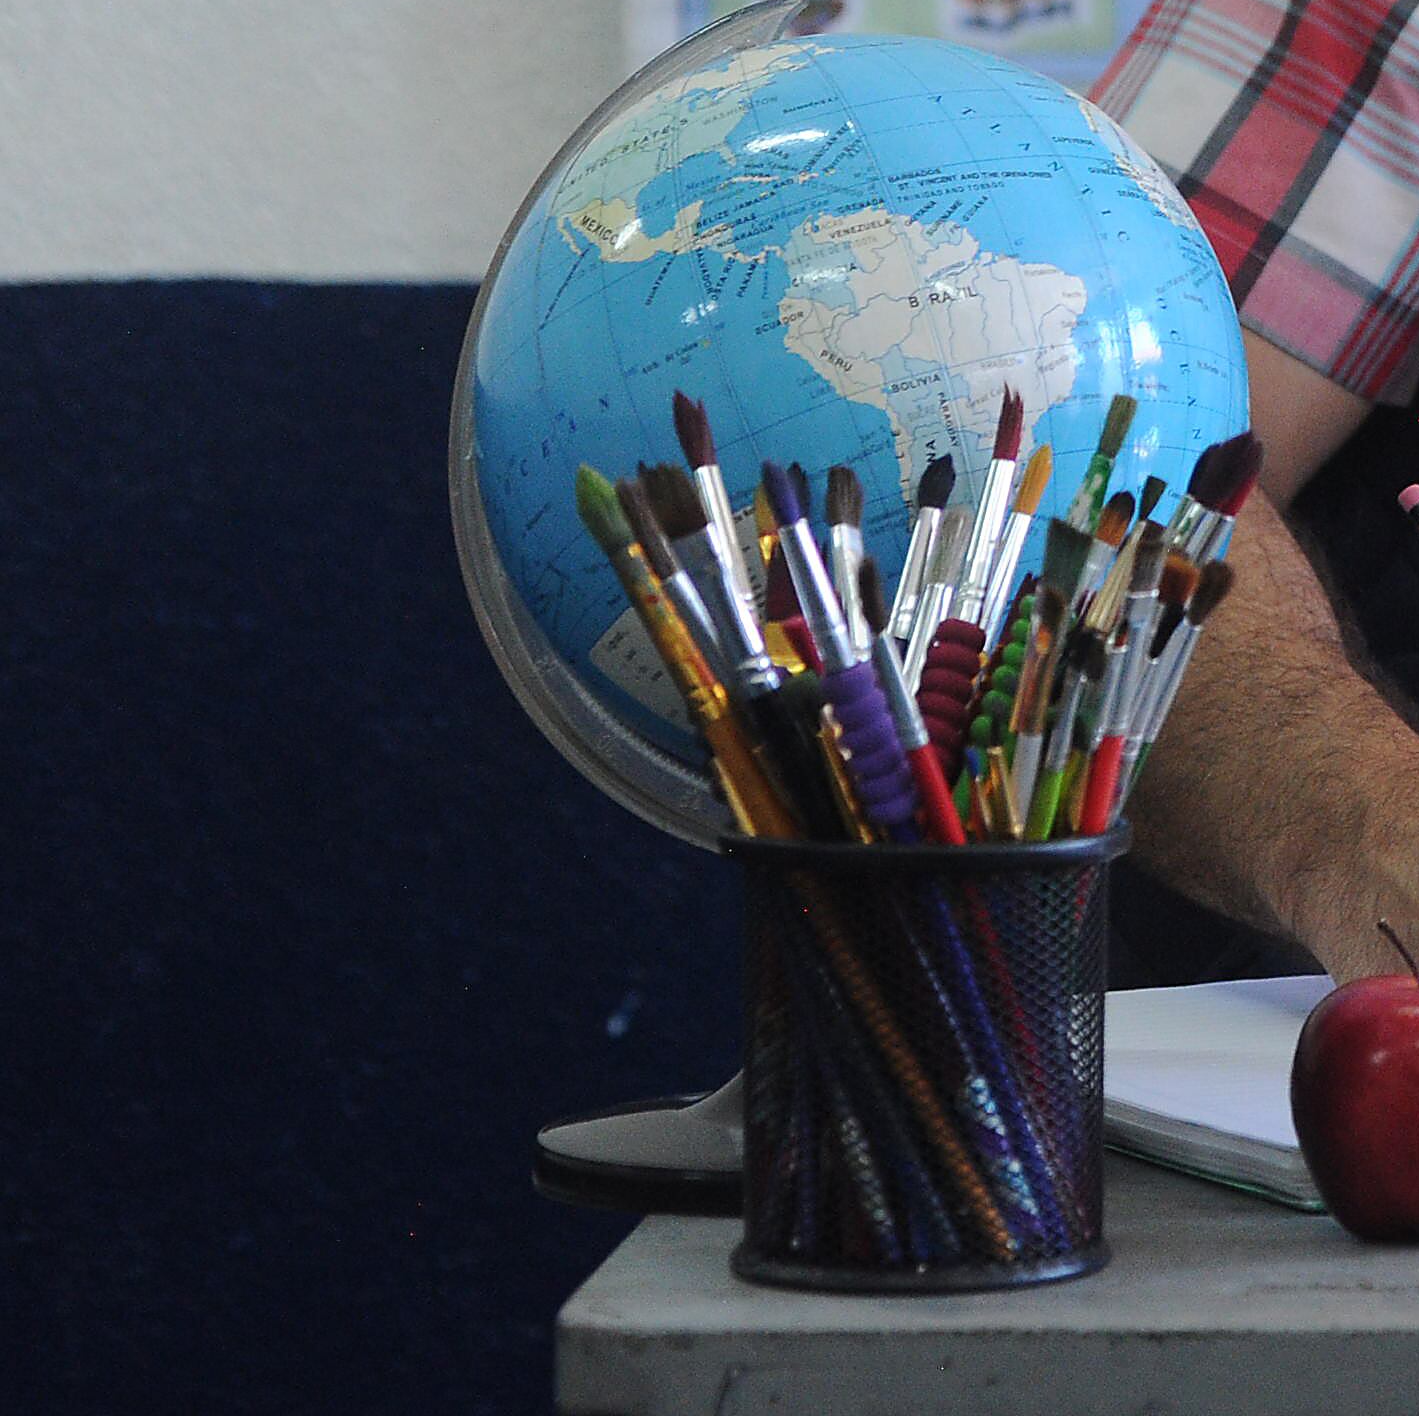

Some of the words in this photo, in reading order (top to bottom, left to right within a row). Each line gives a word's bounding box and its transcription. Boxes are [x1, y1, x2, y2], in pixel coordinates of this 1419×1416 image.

[697, 210, 730, 228] BELIZE
[829, 218, 892, 239] VENEZUELA
[716, 225, 774, 249] NICARAGUA
[755, 311, 804, 335] ECUADOR
[820, 349, 853, 372] PERU
[891, 373, 942, 393] BOLIVIA
